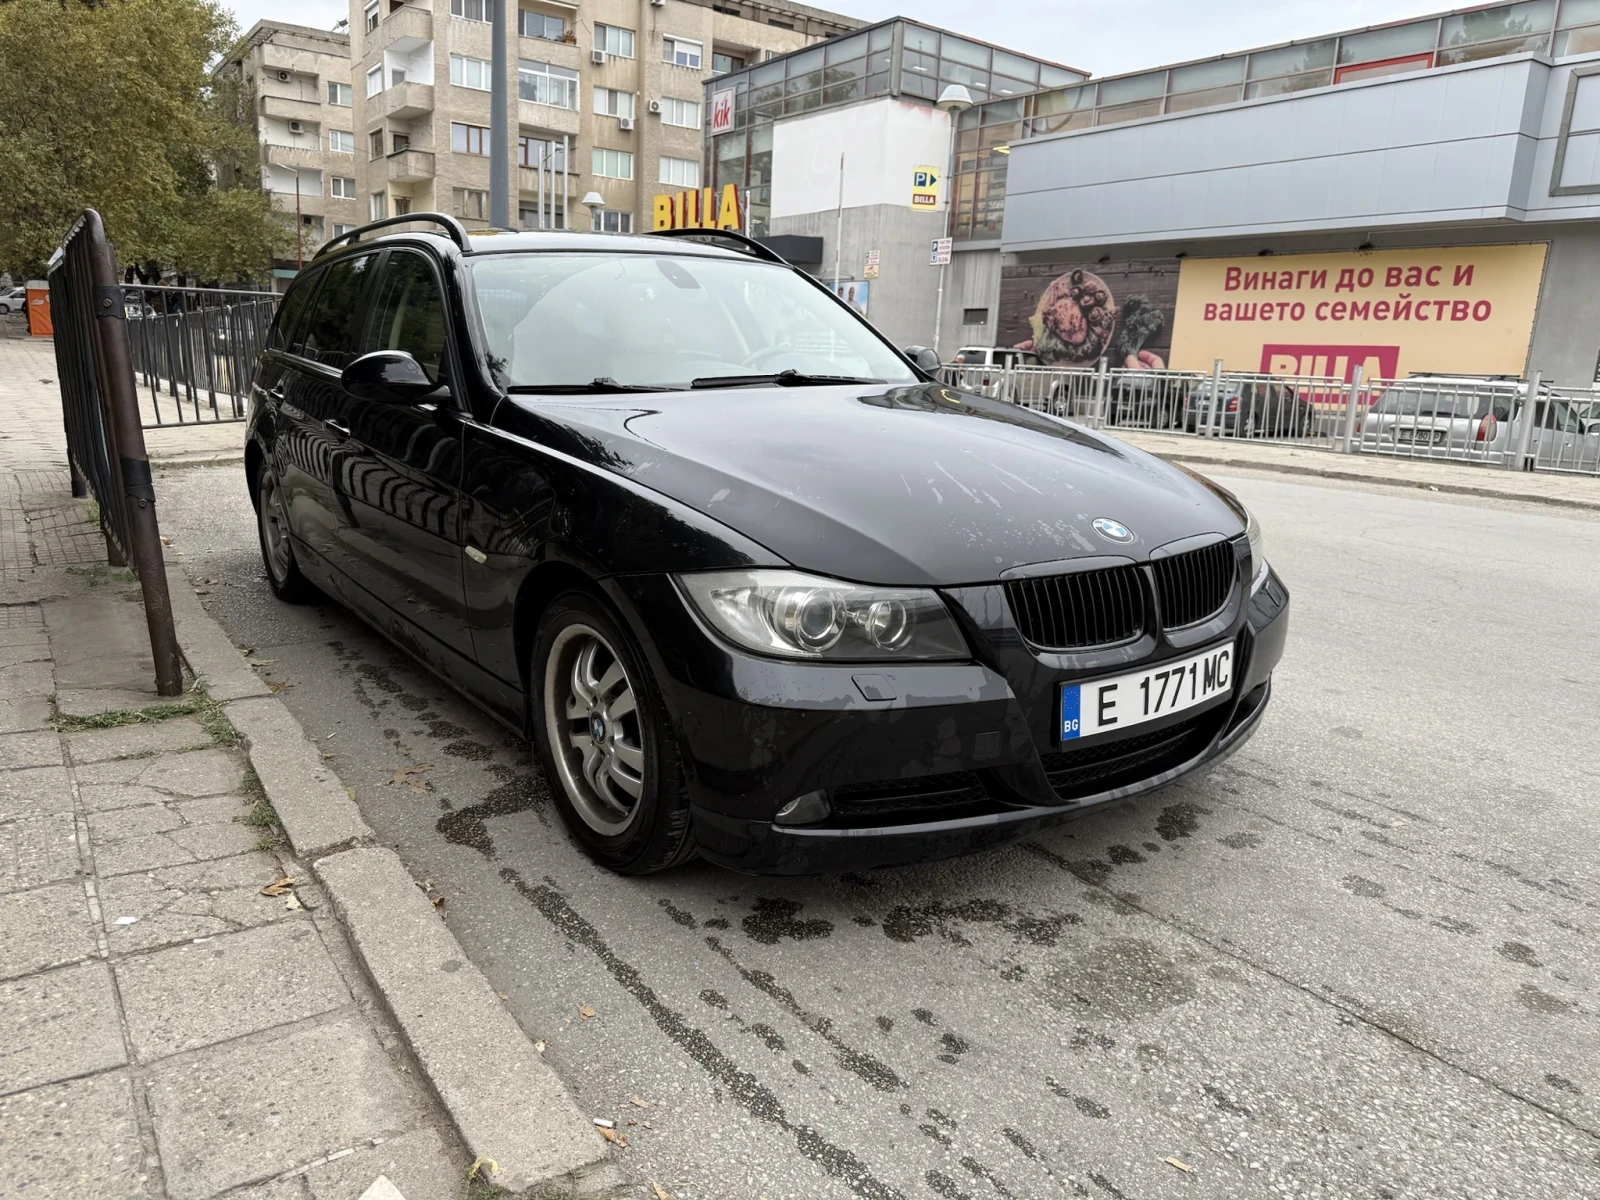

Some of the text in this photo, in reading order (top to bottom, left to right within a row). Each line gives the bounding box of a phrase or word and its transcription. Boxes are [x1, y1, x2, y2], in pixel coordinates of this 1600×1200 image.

[653, 183, 742, 231] BILLA
[914, 195, 935, 205] BILLA
[1224, 264, 1475, 293] Винаги до вас и
[1203, 293, 1492, 321] вашето семейство
[1098, 683, 1118, 727] E
[1064, 718, 1079, 733] BG
